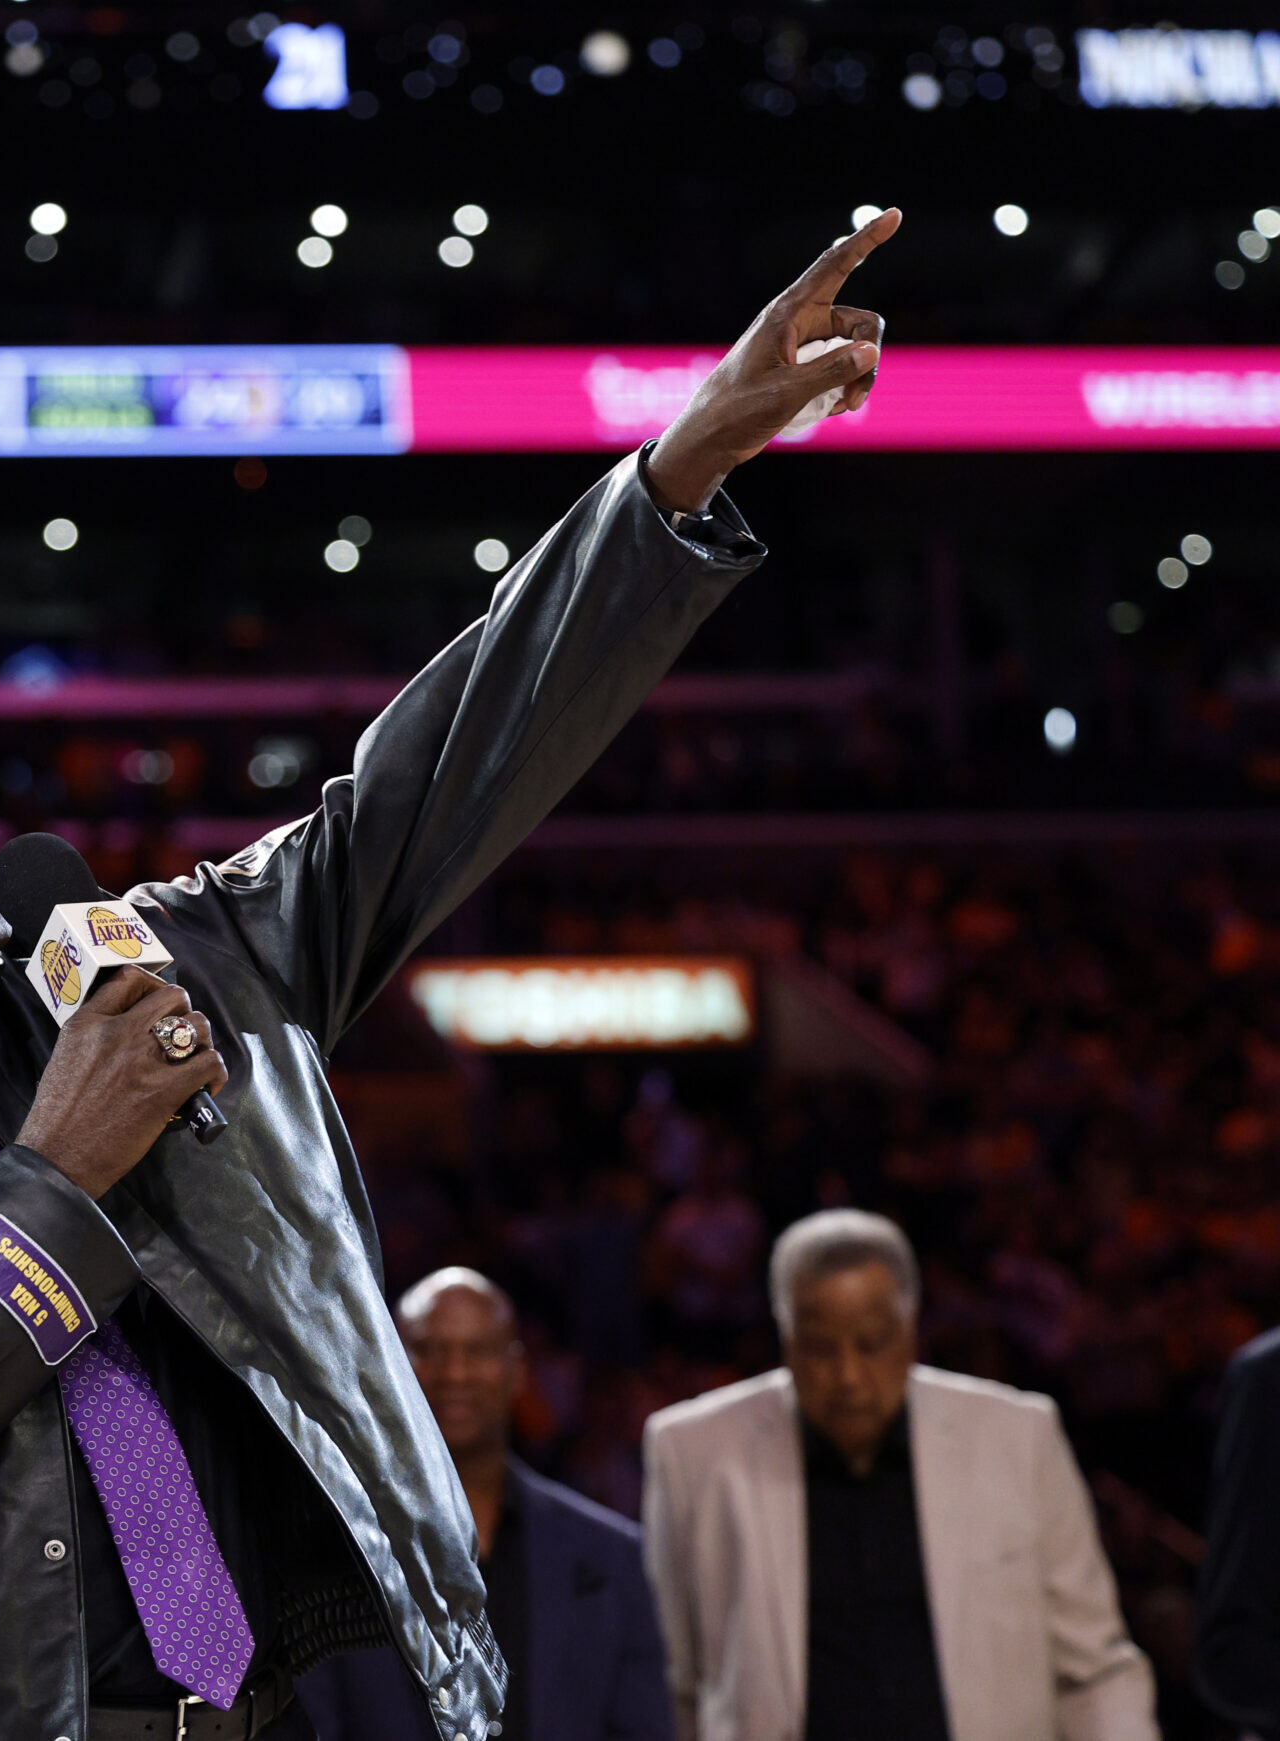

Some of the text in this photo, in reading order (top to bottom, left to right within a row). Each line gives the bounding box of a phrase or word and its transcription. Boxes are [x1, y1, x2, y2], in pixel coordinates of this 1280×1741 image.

[265, 23, 348, 109] 21
[84, 919, 152, 947] LAKERS
[108, 916, 139, 924] ANGELES
[42, 935, 82, 1013] LAKERS
[9, 1282, 49, 1327] 5 NBA
